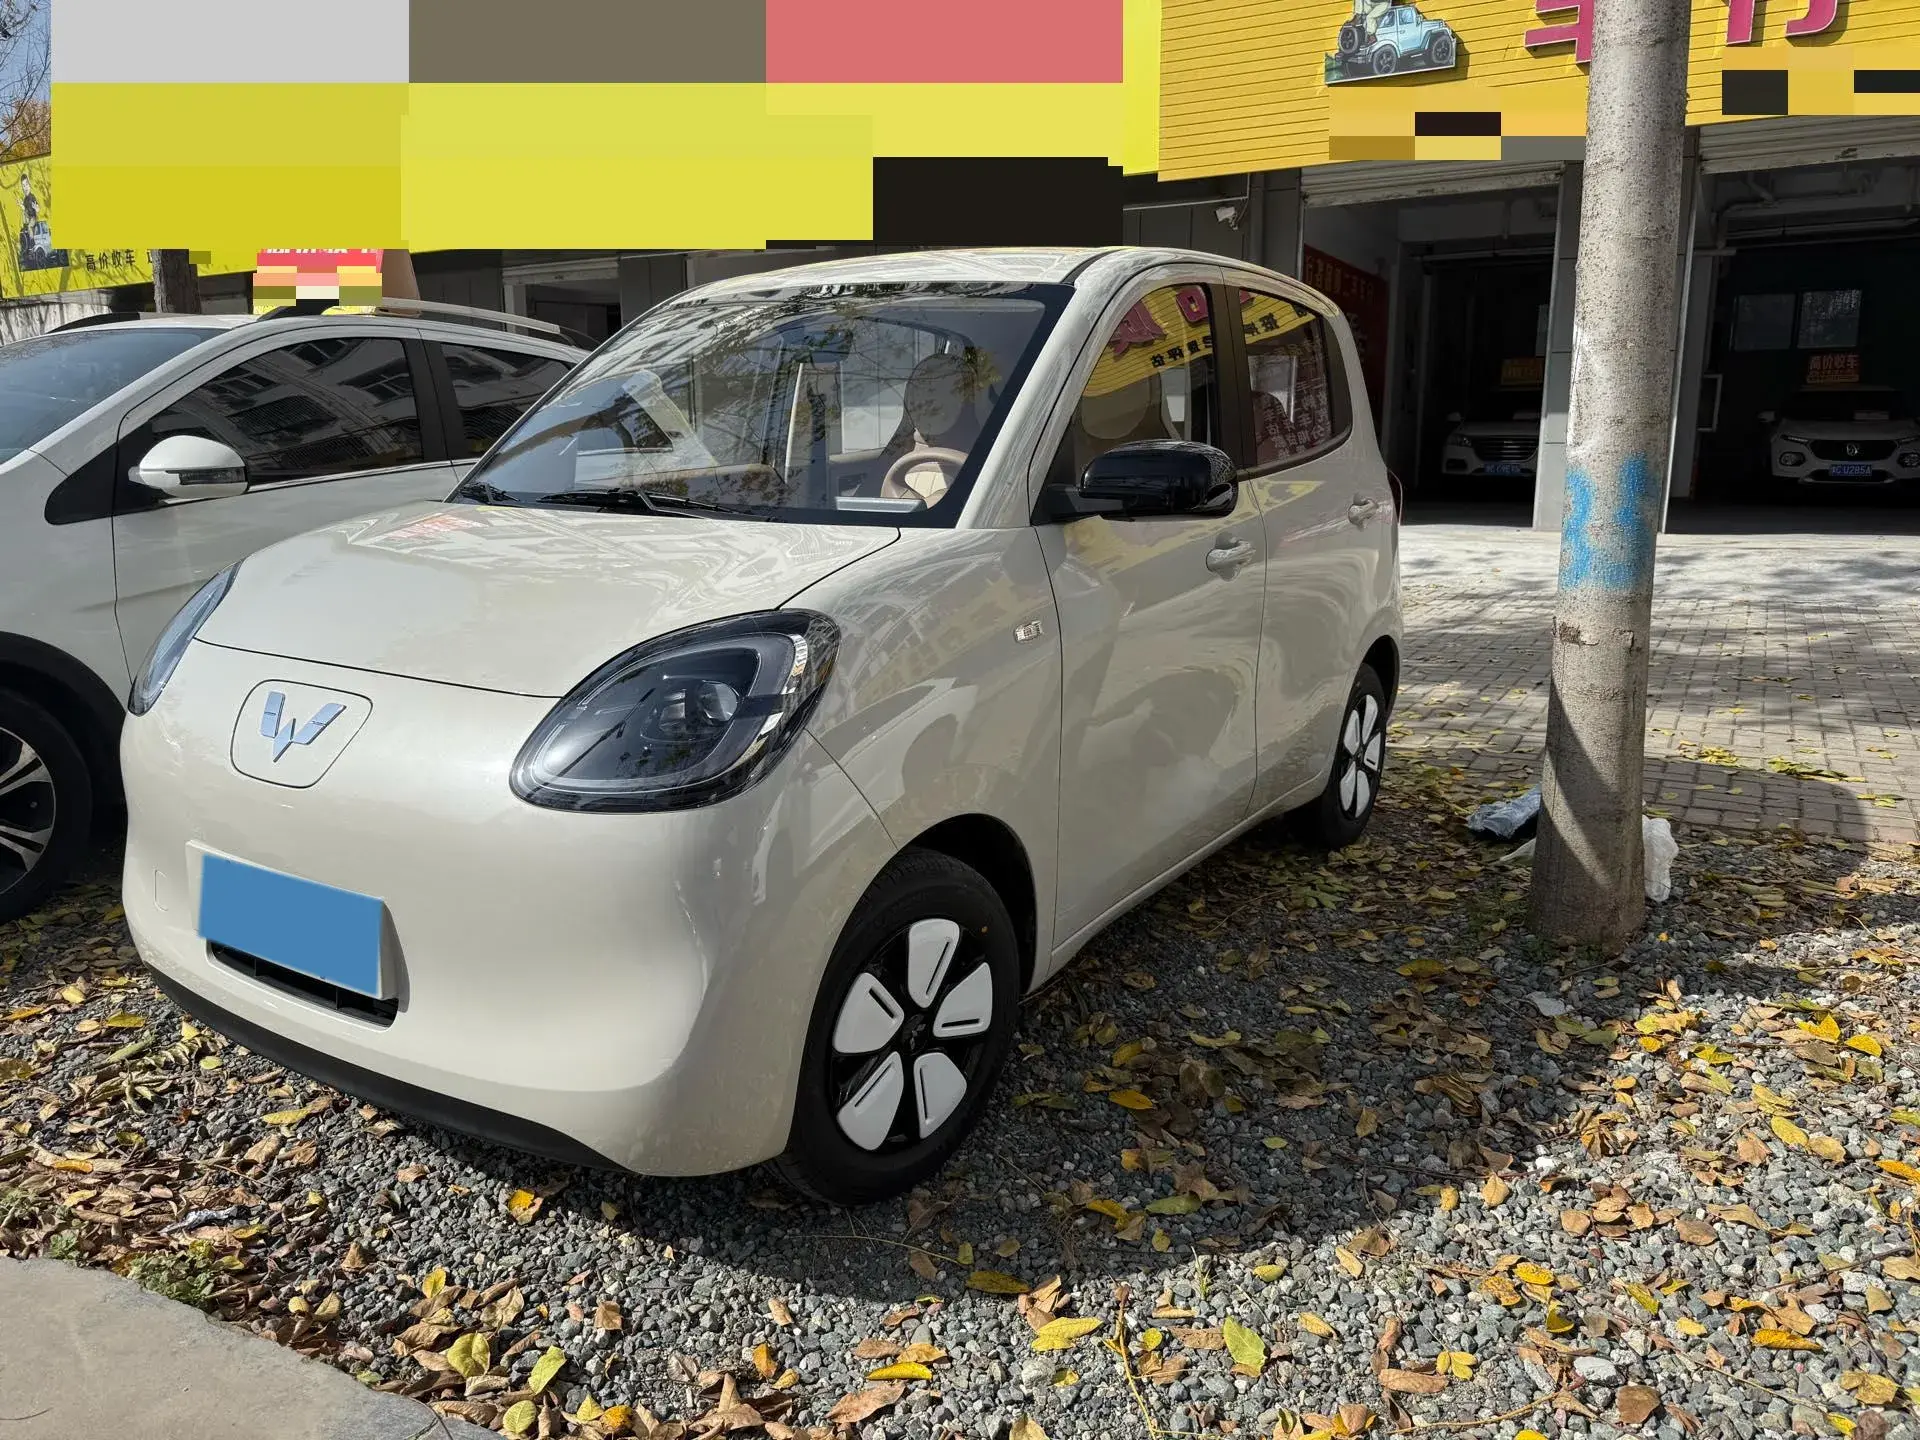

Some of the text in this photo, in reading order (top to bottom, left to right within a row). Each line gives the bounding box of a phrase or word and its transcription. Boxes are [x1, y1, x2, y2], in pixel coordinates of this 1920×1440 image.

[85, 248, 135, 272] 高价收车
[1809, 353, 1860, 371] 高价收车
